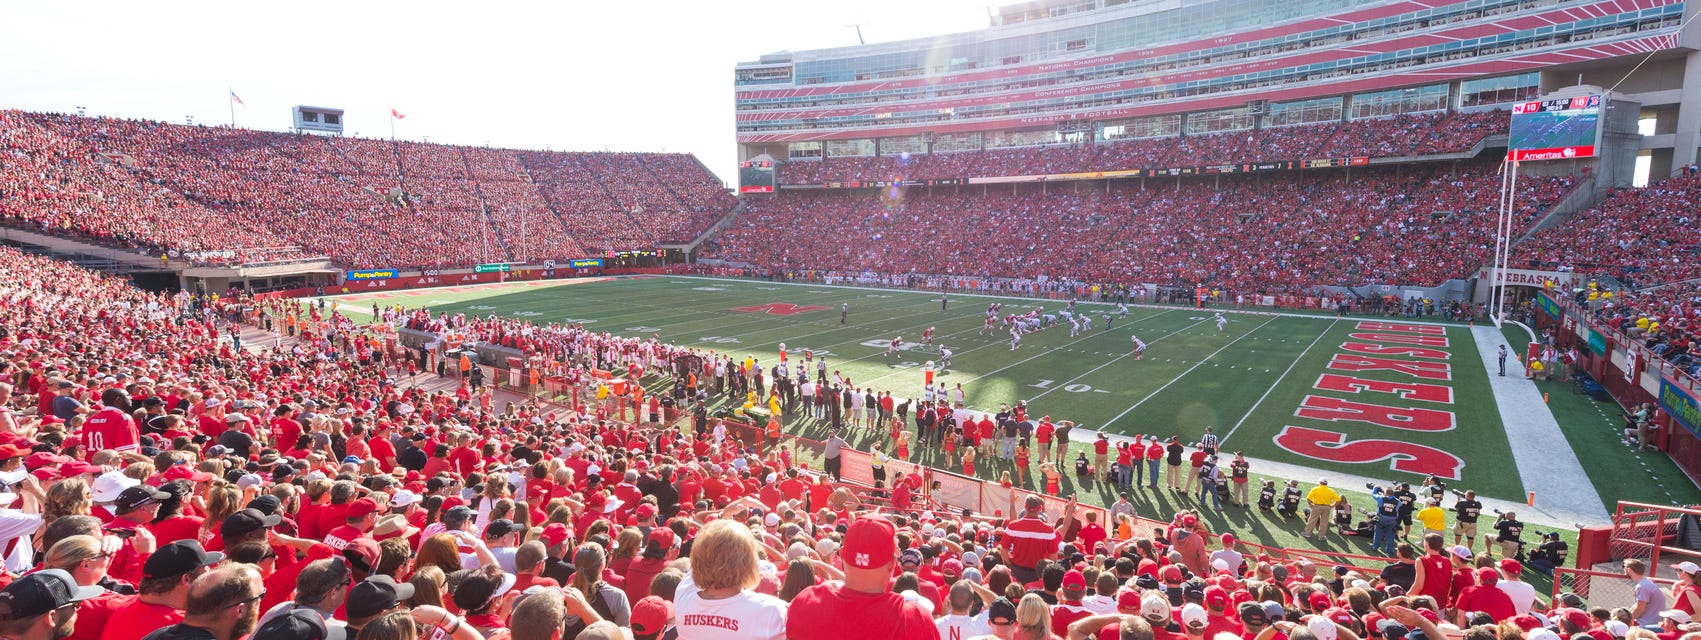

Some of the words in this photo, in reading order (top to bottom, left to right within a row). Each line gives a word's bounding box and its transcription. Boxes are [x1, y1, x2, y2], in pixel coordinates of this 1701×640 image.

[1073, 56, 1114, 66] CHAMPIONS
[1035, 88, 1077, 97] CONFERENCE
[1080, 82, 1121, 92] CHAMPIONS
[1526, 103, 1537, 111] 10
[1021, 115, 1065, 123] NEBRASKA
[1084, 108, 1129, 118] FOOTBALL
[1522, 151, 1562, 160] Ameritas
[1272, 321, 1466, 481] HUSKERS
[87, 431, 104, 451] 10
[684, 614, 739, 632] HUSKERS
[949, 625, 960, 640] N
